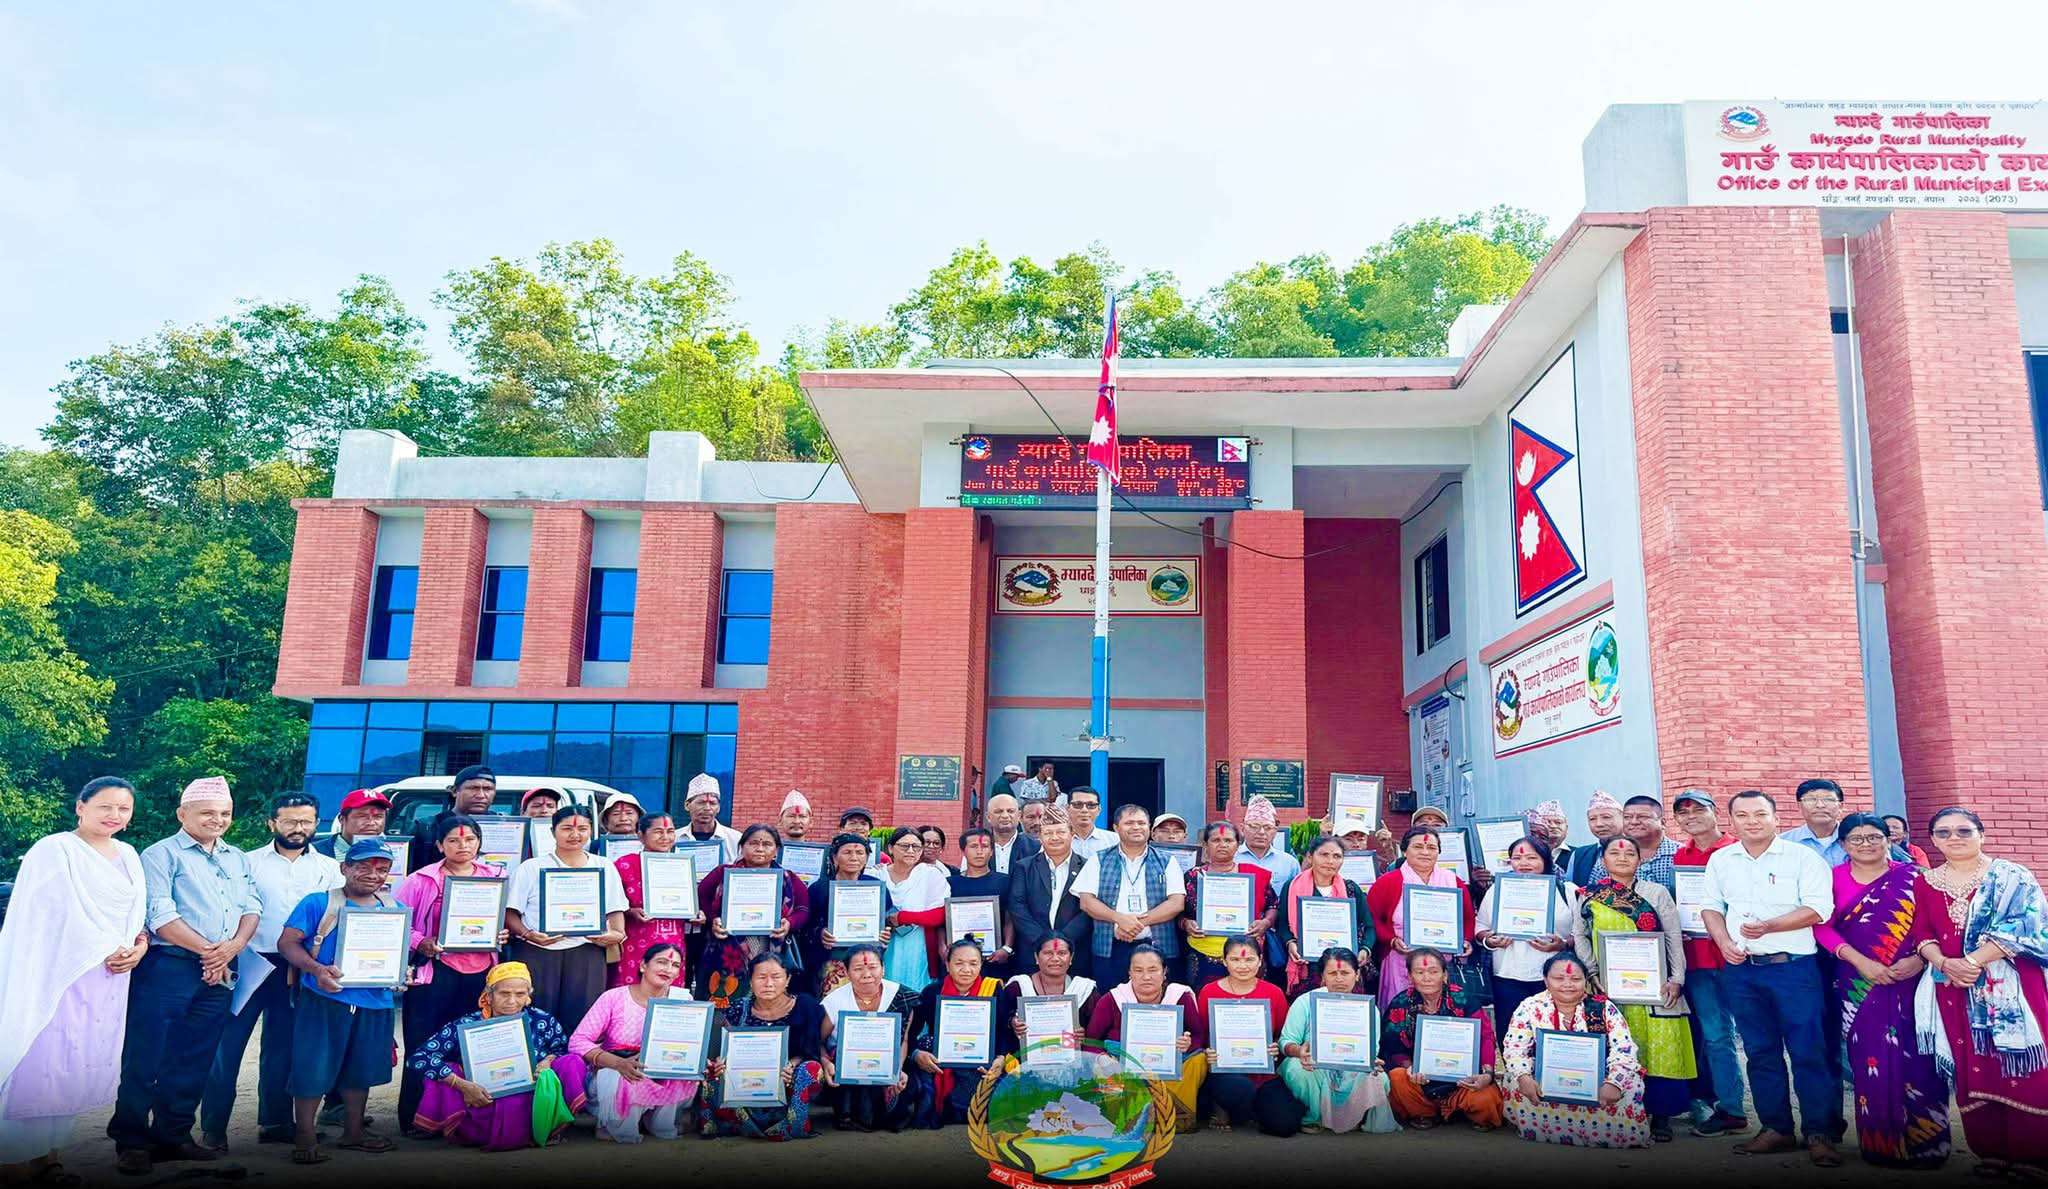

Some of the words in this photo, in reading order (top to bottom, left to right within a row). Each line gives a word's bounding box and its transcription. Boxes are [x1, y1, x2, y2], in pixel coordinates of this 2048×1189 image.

[1834, 112, 1883, 130] म्याग्दे
[1892, 112, 1991, 130] गाउँपालिका
[1810, 134, 1874, 147] Myagde
[1880, 134, 1921, 145] Rural
[1928, 134, 2027, 148] Municipality
[1720, 144, 1779, 170] गाउँ
[1788, 146, 1990, 172] कार्यपालिकाको
[1717, 175, 1780, 190] Office
[1788, 175, 1809, 190] of
[1816, 175, 1848, 190] the
[1855, 175, 1908, 191] Rural
[1914, 176, 2011, 193] Municipal
[1985, 194, 2018, 204] (2073)
[964, 480, 986, 489] Jun
[1060, 564, 1095, 581] म्याग्दे
